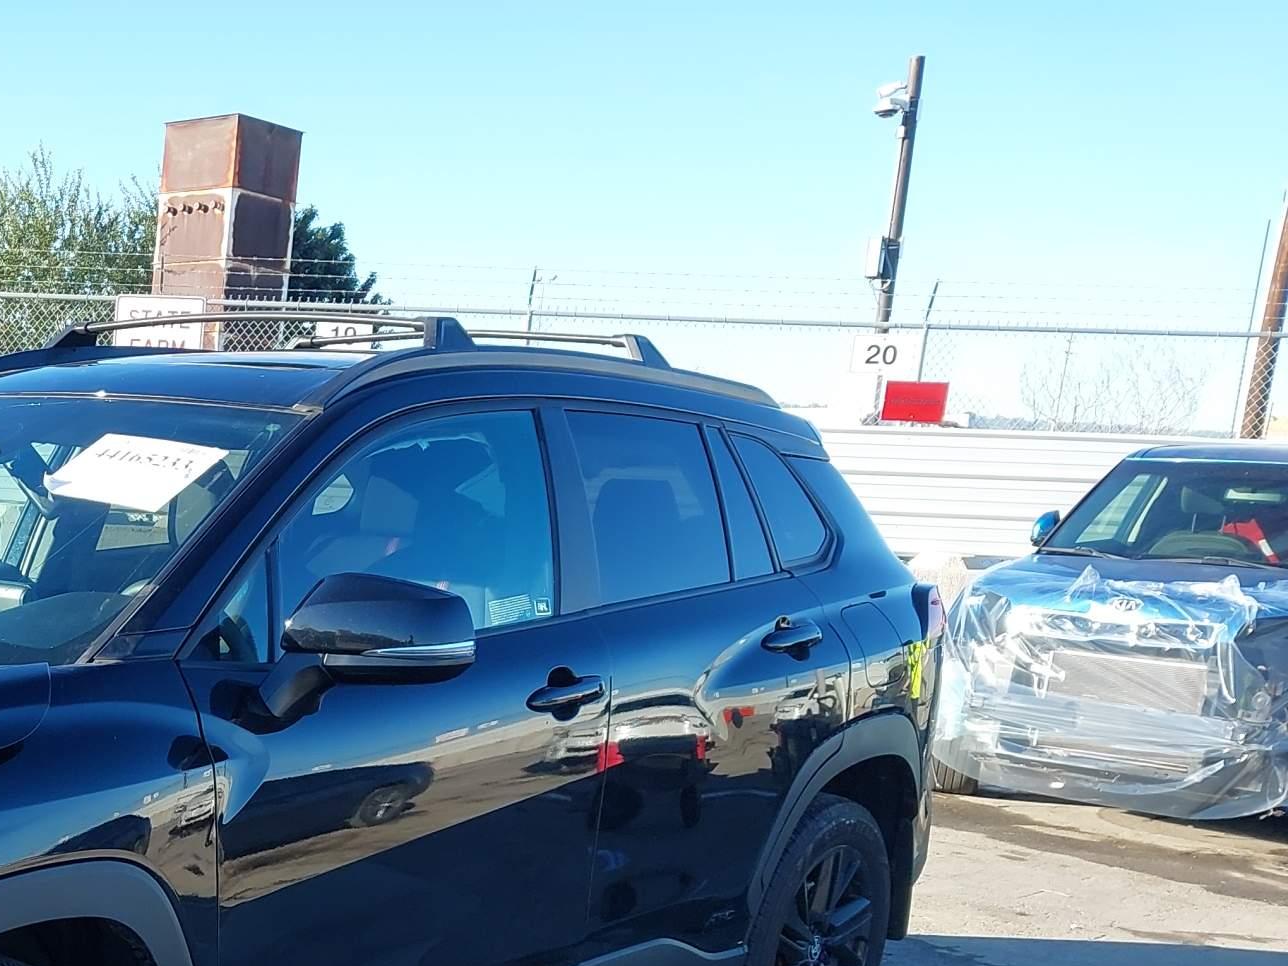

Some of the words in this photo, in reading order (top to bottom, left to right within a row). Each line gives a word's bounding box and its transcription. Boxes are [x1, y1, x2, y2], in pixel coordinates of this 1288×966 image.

[129, 309, 191, 329] STATE
[865, 345, 898, 365] 20
[1112, 599, 1137, 612] KIA
